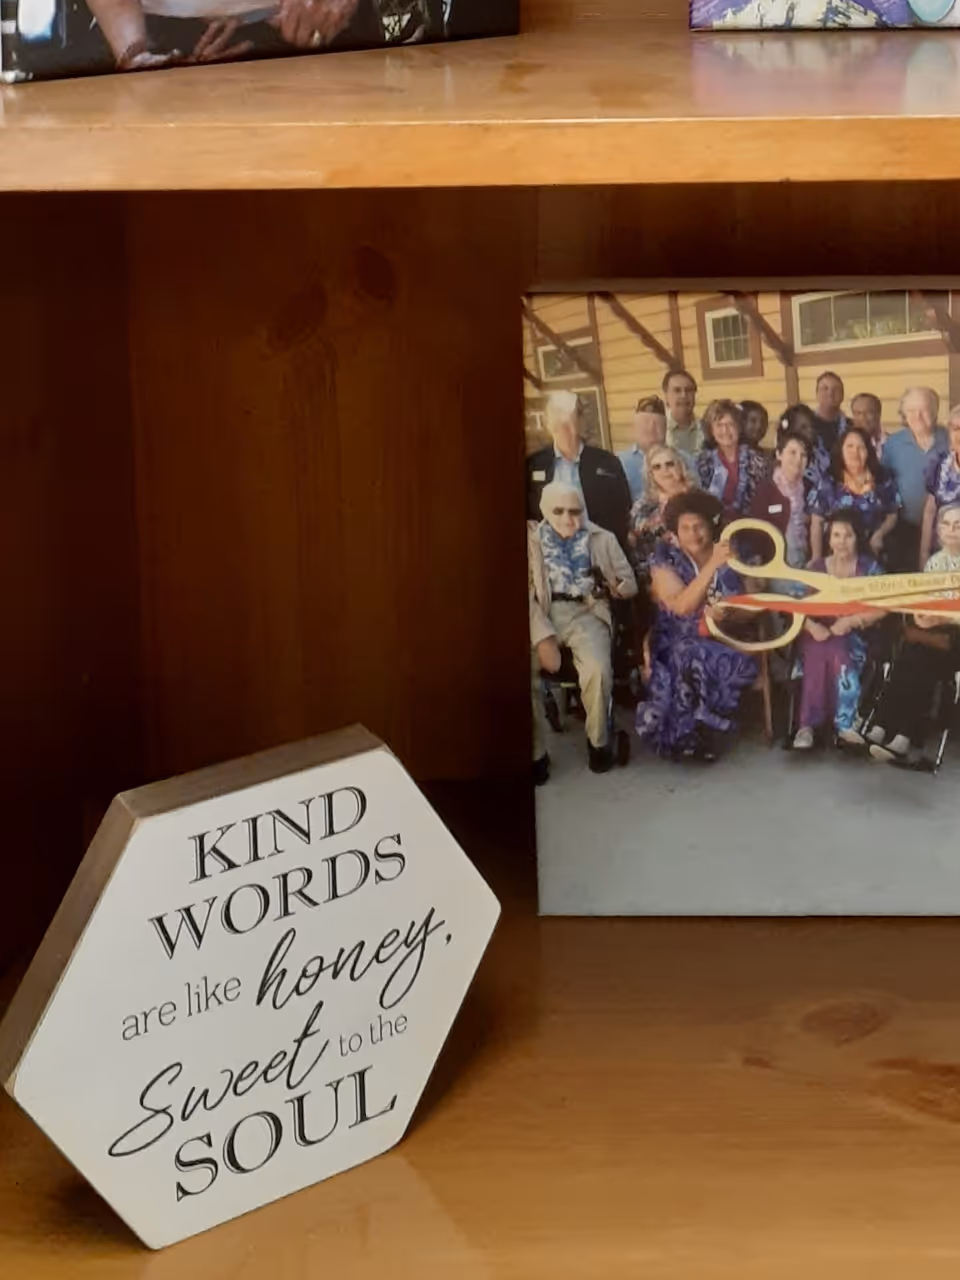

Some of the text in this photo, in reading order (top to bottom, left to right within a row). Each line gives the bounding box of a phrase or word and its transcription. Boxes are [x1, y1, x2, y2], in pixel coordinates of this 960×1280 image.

[148, 833, 407, 960] WORDS
[188, 786, 368, 884] KIND
[121, 907, 454, 1042] are like honey.
[107, 1000, 409, 1157] Sweet to the
[174, 1065, 398, 1202] SOUL
